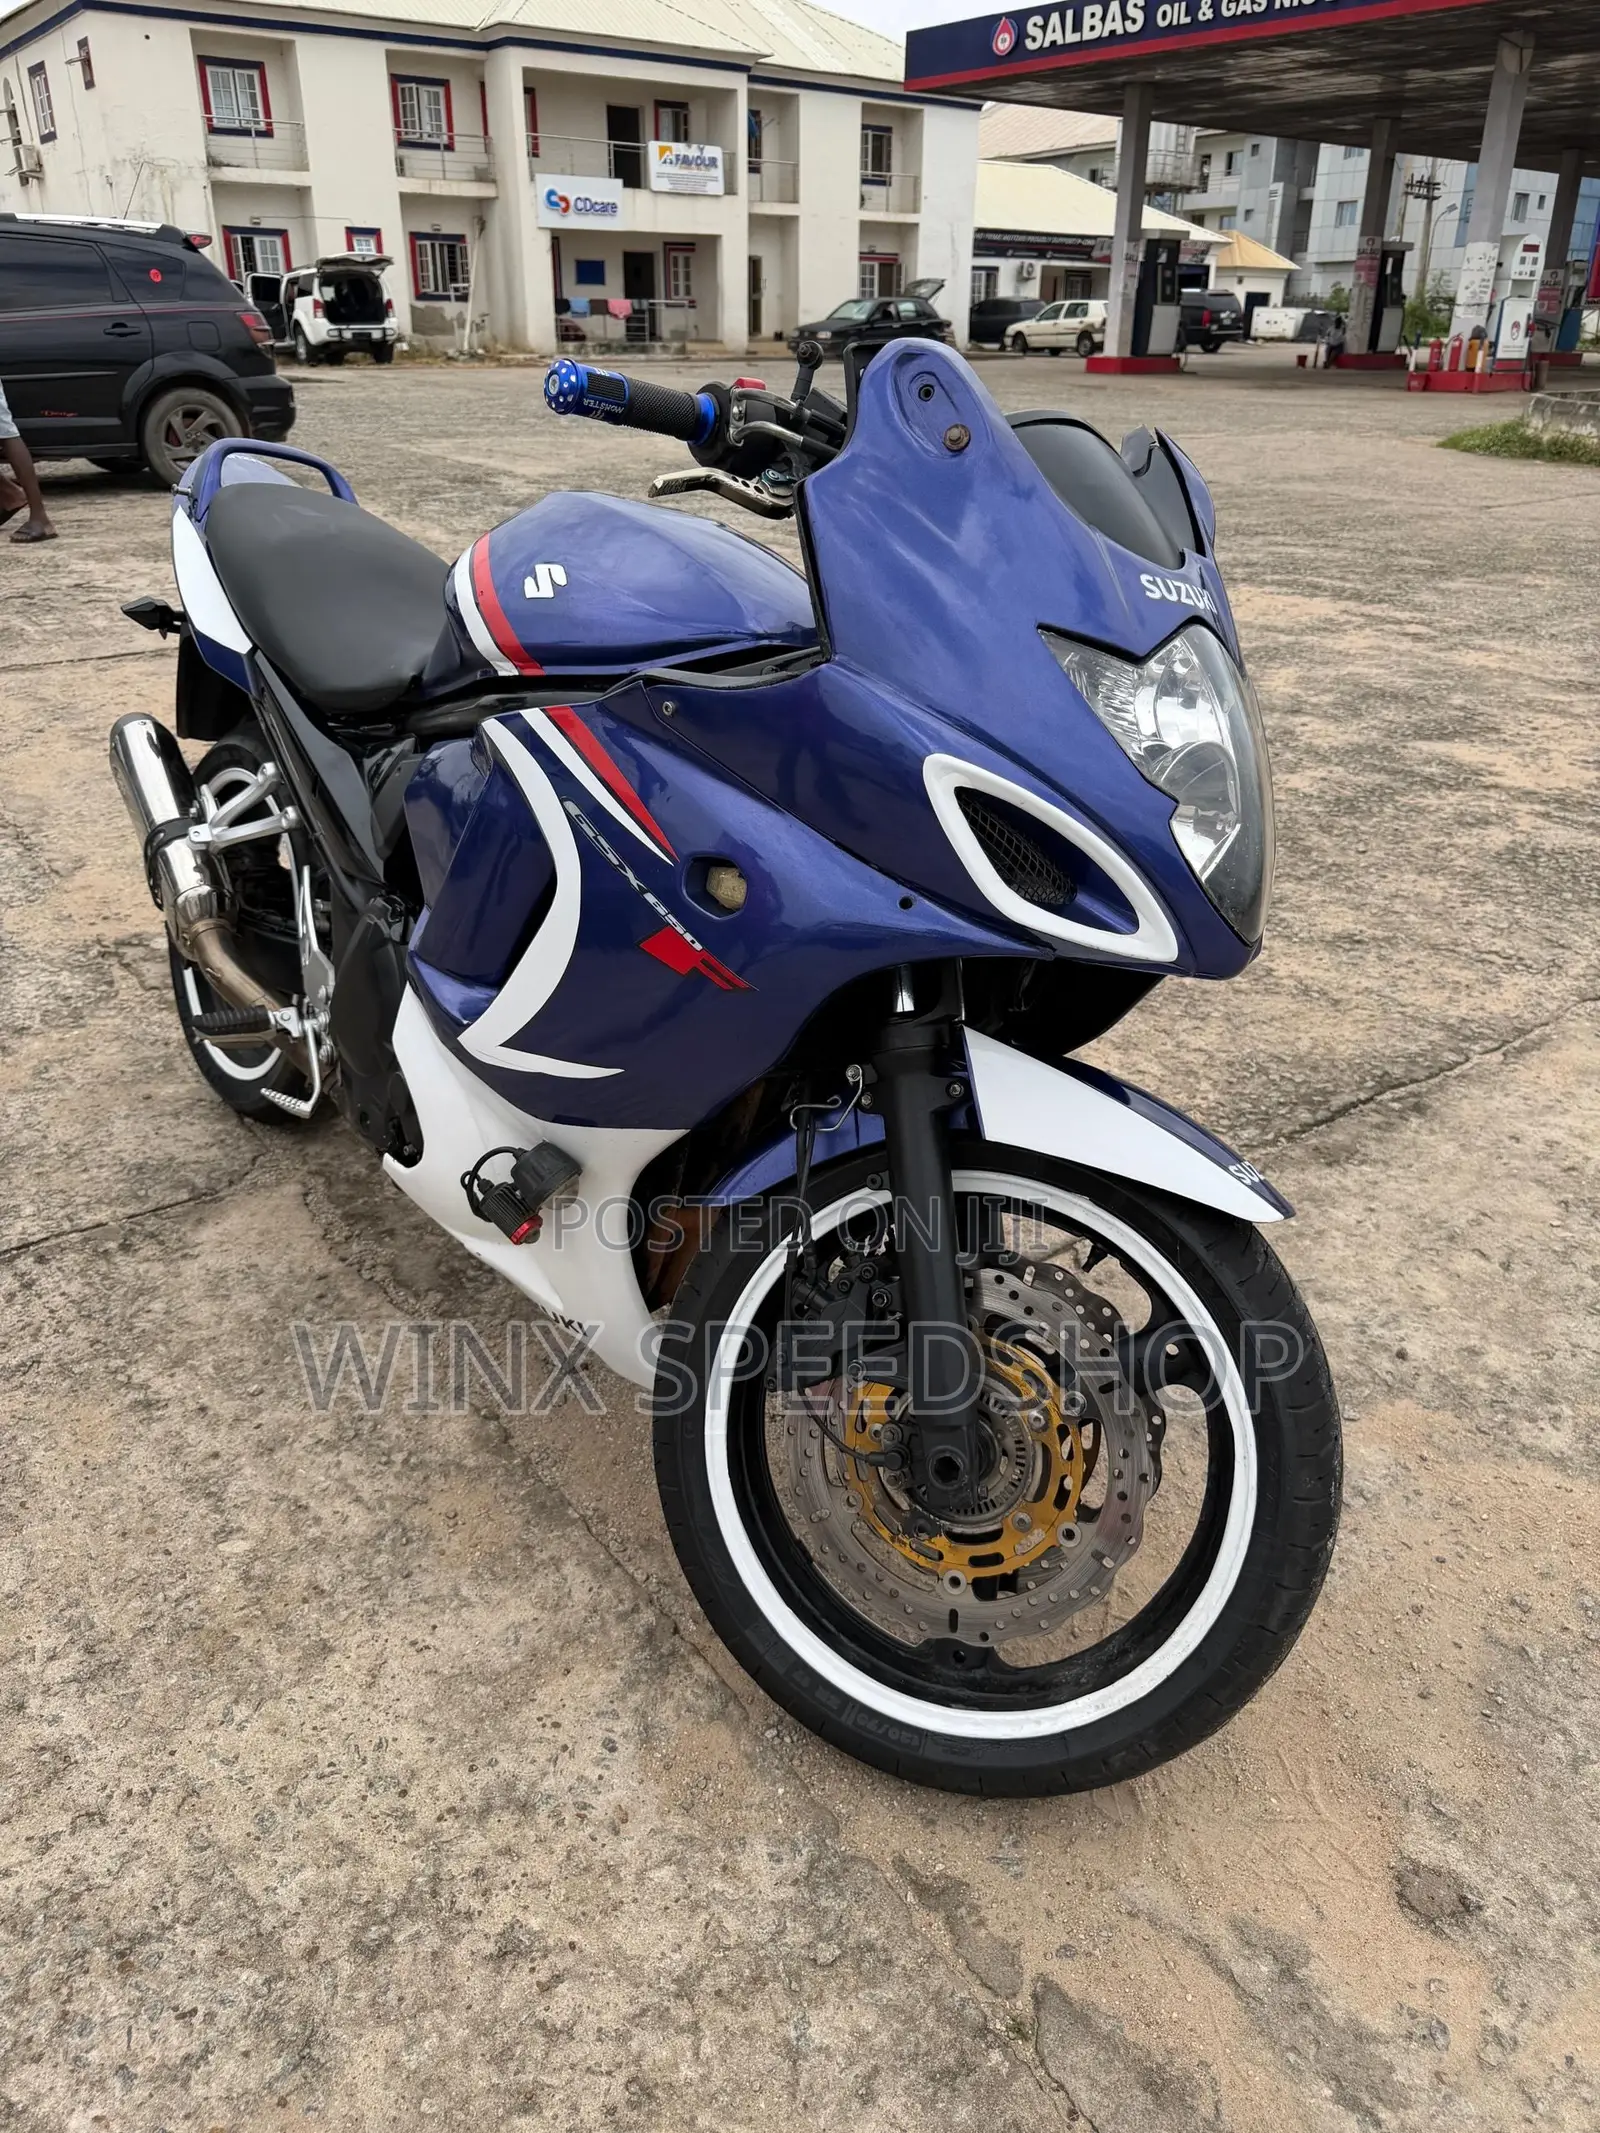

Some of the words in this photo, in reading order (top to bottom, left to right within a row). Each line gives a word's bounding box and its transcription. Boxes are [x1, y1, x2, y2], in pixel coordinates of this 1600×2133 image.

[1024, 0, 1145, 51] SALBAS
[1156, 4, 1192, 28] OIL
[1197, 0, 1215, 21] &
[1221, 0, 1268, 17] GAS
[573, 196, 619, 214] CDcare
[583, 397, 625, 415] MONSTER
[1139, 573, 1218, 615] SUZUKI
